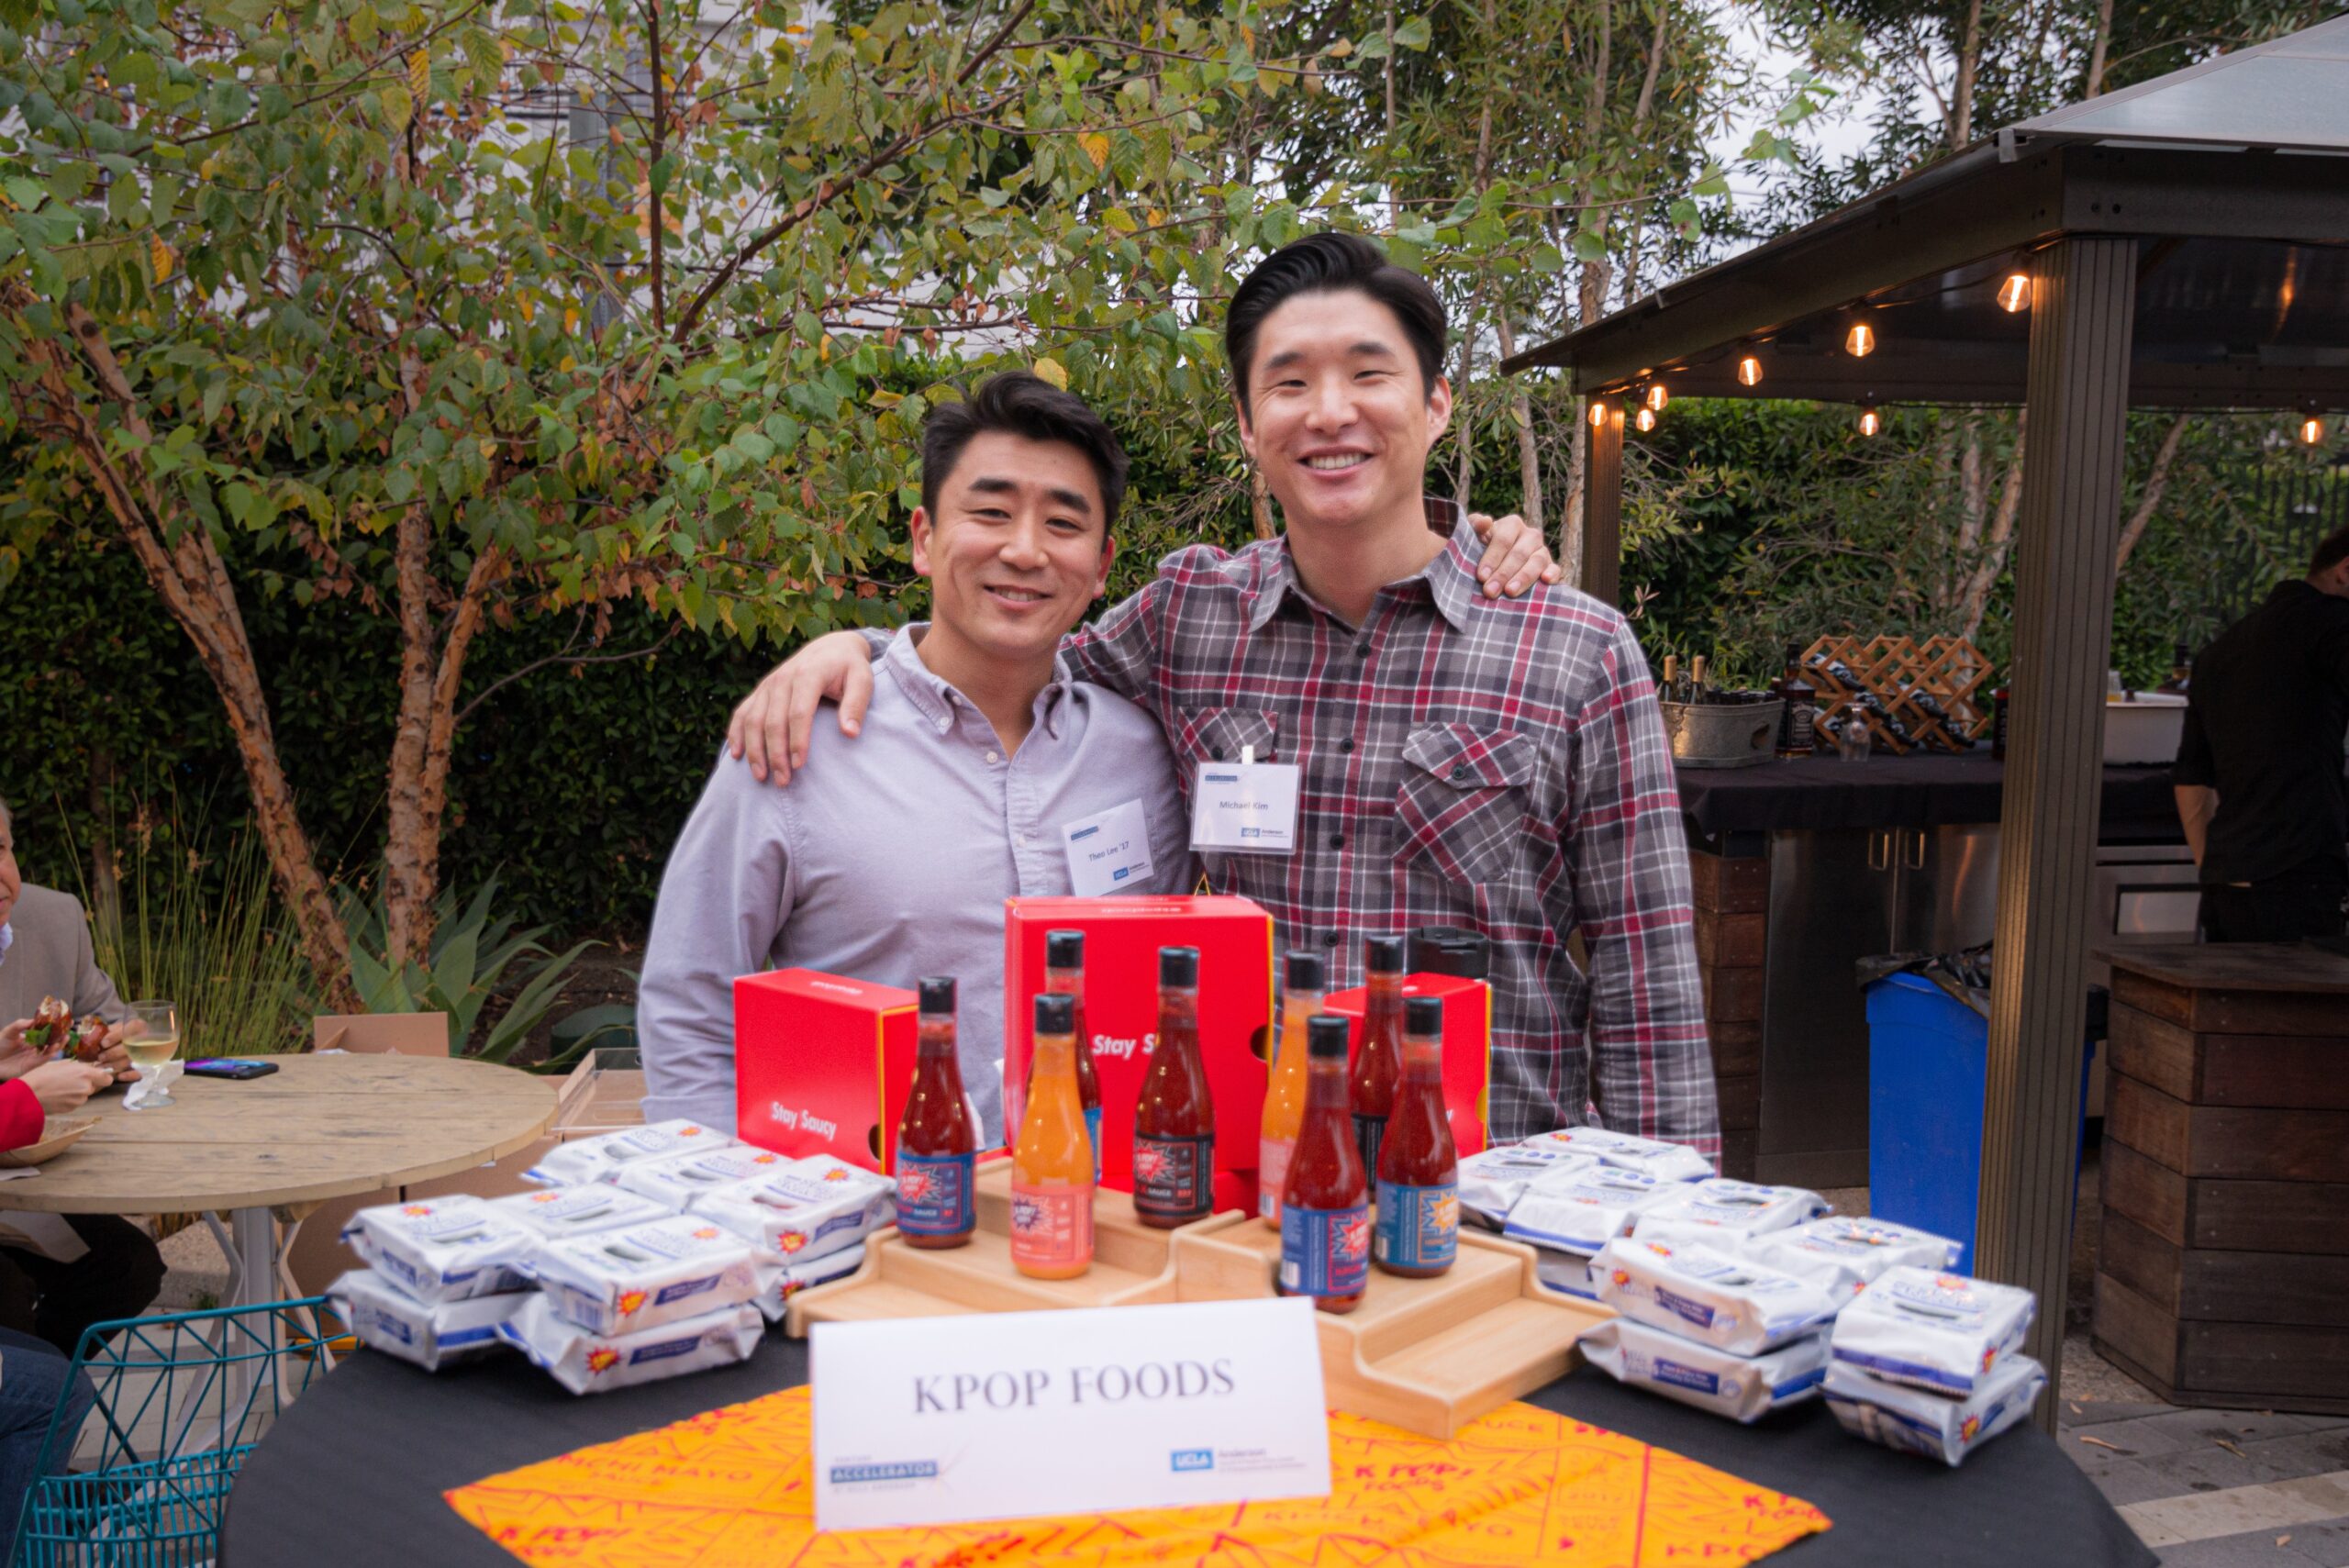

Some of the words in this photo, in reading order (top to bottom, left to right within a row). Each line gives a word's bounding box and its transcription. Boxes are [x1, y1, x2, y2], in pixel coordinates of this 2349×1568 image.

[1219, 800, 1251, 809] Michael
[1253, 801, 1269, 810] Kim
[1088, 851, 1106, 862] Theo
[1107, 846, 1119, 856] Lee
[1119, 840, 1130, 851] '17
[1092, 1033, 1137, 1060] Stay
[771, 1101, 797, 1130] Stay
[801, 1108, 837, 1141] Saucy
[913, 1367, 1051, 1414] KPOP
[1070, 1357, 1235, 1404] FOODS
[833, 1462, 934, 1480] ACCELERATOR
[1174, 1451, 1209, 1469] UCLA
